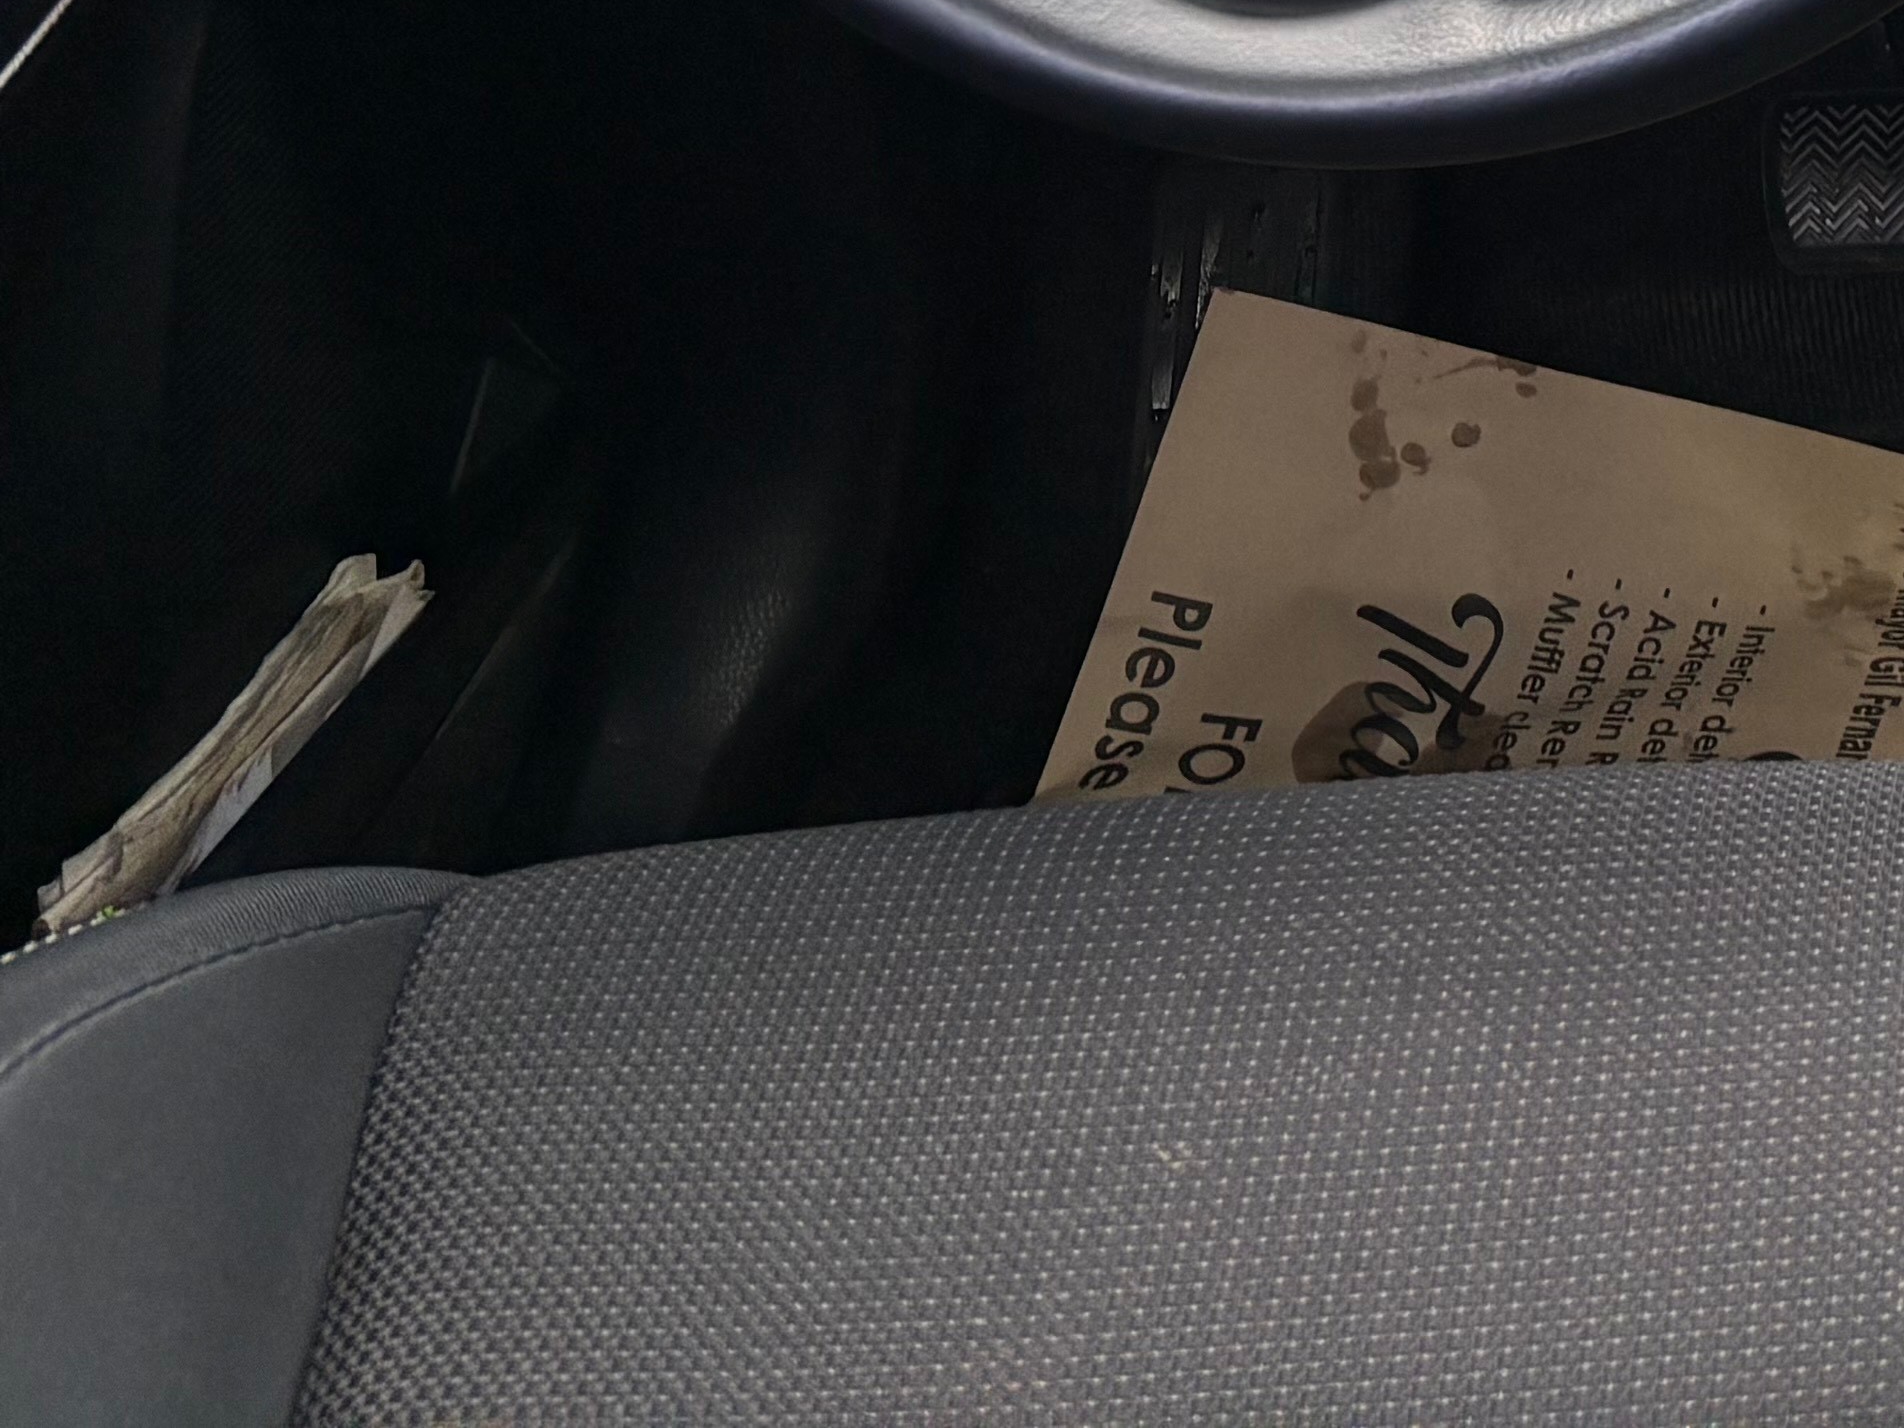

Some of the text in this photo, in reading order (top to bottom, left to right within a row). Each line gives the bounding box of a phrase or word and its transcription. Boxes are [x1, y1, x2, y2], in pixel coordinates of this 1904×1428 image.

[1078, 590, 1213, 792] Please
[1517, 591, 1582, 705] Muffler
[1566, 601, 1630, 713] Scratch
[1625, 610, 1677, 684] Acid
[1660, 619, 1727, 712] Exterior
[1711, 624, 1775, 708] Interior
[1163, 712, 1263, 794] FO
[1599, 689, 1648, 742] Rain
